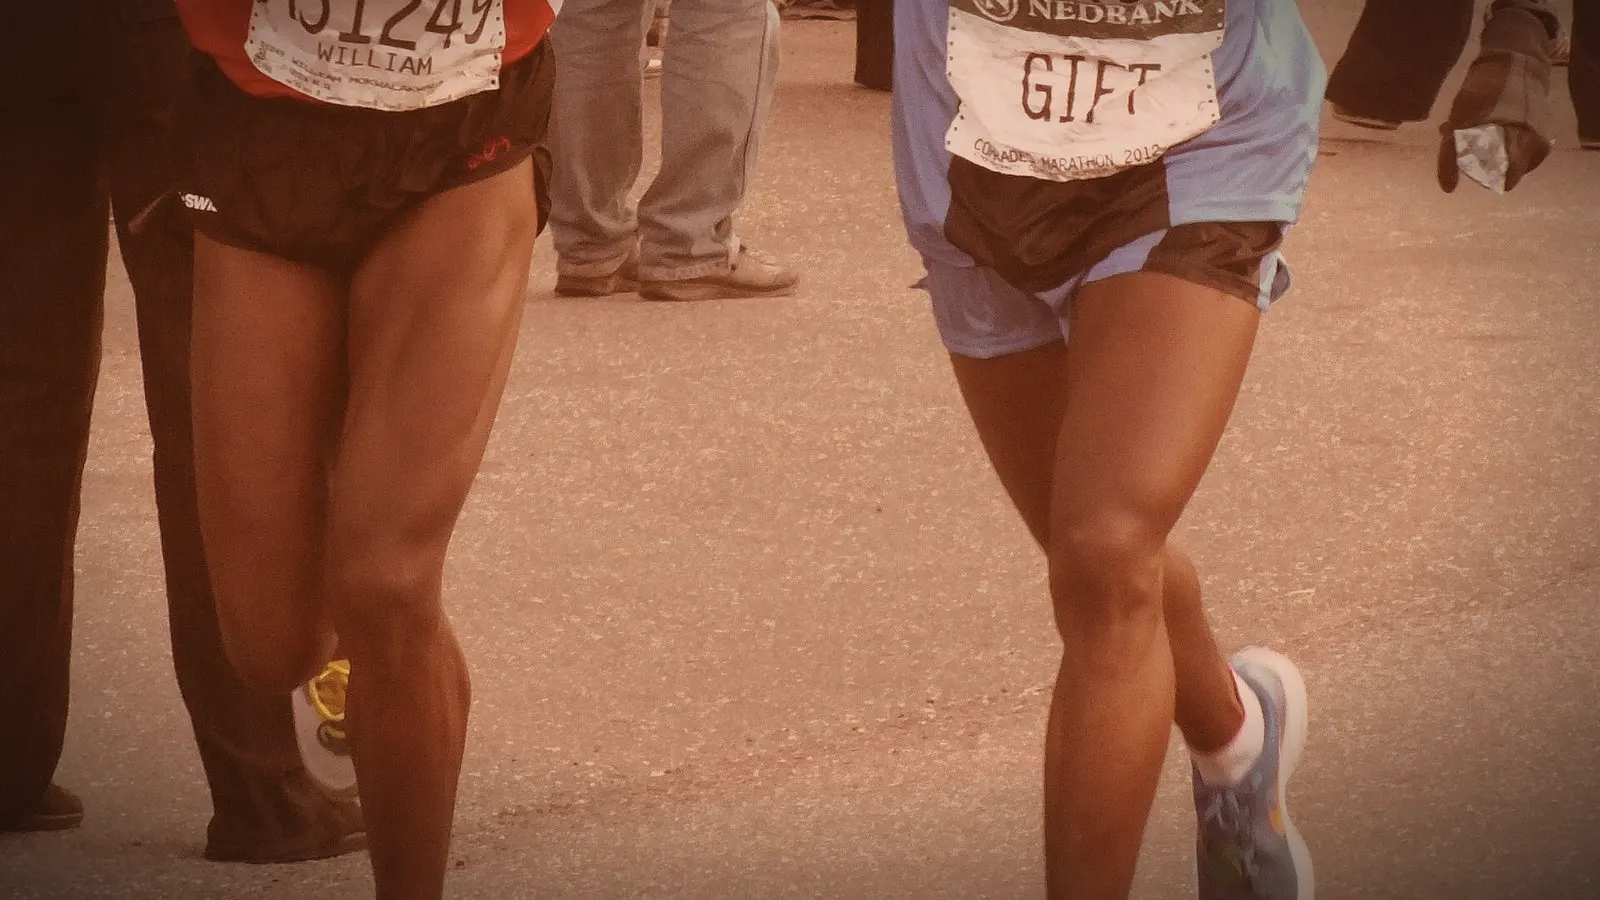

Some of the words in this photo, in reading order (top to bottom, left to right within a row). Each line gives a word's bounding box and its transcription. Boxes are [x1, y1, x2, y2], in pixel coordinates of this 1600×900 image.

[1029, 0, 1203, 25] NEDBANK
[317, 42, 433, 75] WILLIAM
[1022, 53, 1161, 123] GIFT
[1041, 153, 1114, 172] MARATHON
[1124, 143, 1161, 164] 2012
